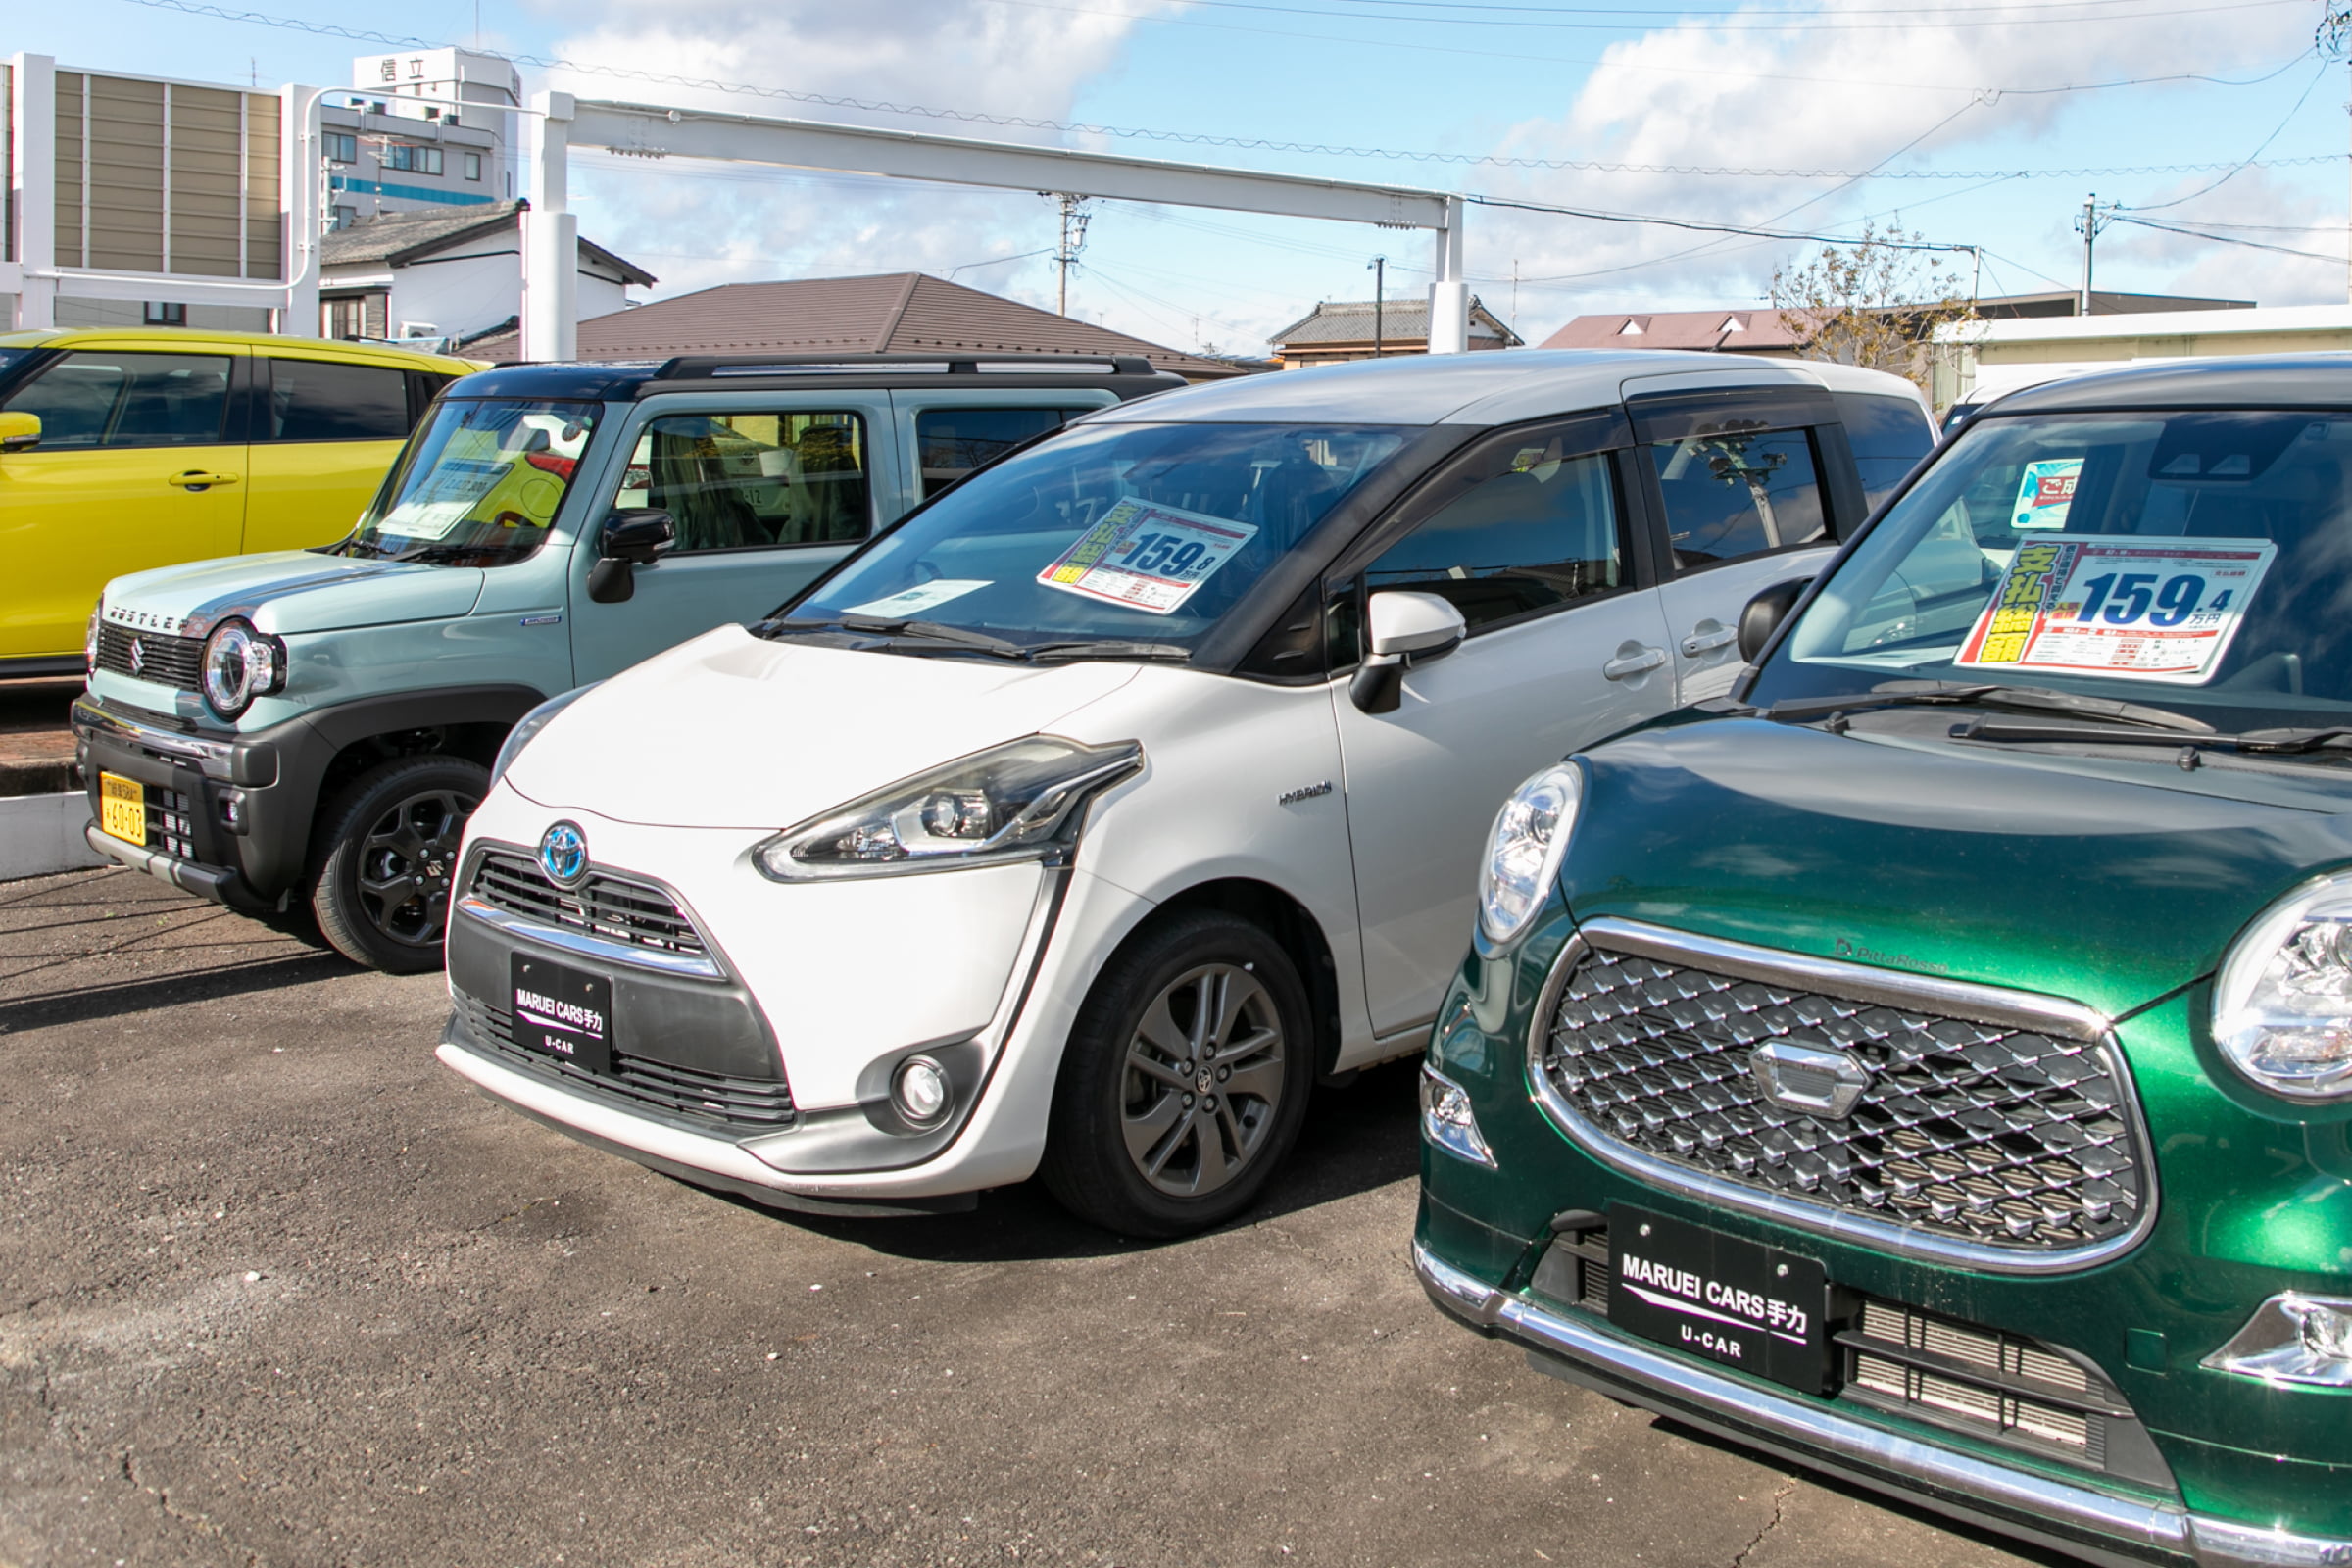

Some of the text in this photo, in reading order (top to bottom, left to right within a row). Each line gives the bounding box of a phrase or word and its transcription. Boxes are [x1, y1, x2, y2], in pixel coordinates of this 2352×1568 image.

[380, 56, 424, 82] 信立
[1978, 544, 2059, 663] 支払総額
[2189, 613, 2222, 624] 万円
[1279, 779, 1332, 806] HYBRID
[1857, 946, 1948, 975] PittaRosso
[516, 988, 555, 1015] MARUEI
[544, 1035, 574, 1054] U-CAR
[1623, 1253, 1701, 1299] MARUEI
[1680, 1324, 1742, 1358] U-CAR
